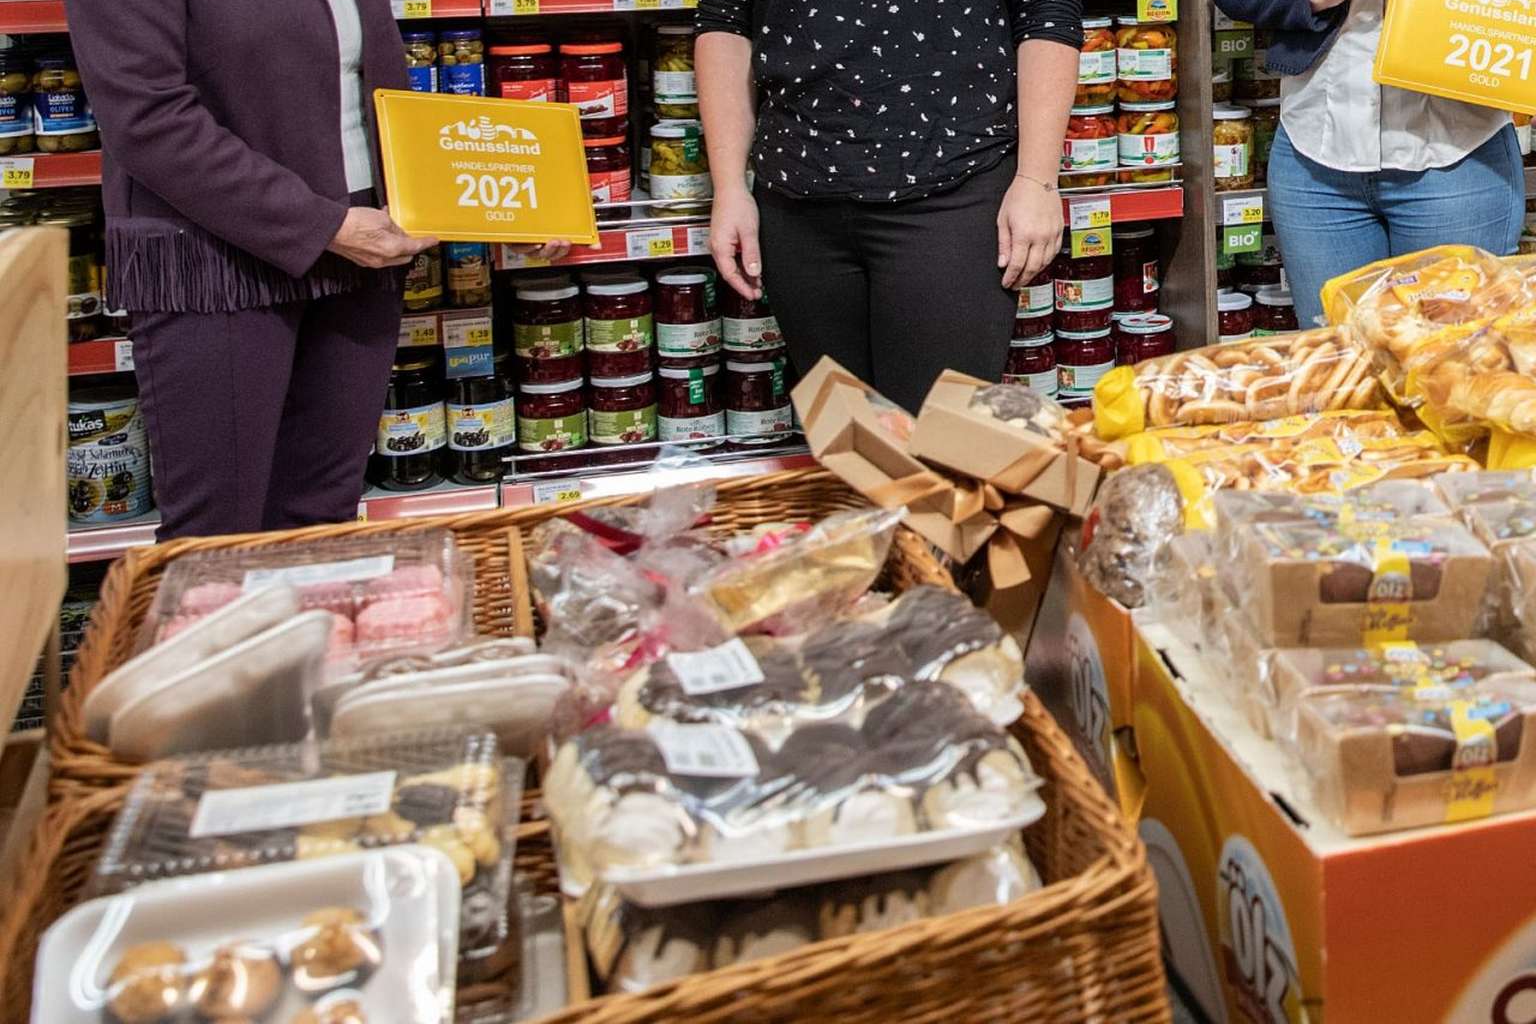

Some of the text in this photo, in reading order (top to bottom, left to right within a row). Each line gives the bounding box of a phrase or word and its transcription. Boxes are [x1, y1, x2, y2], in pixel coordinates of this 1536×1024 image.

[407, 2, 427, 12] 3.79
[1450, 20, 1536, 45] HANDELSPARTNER
[1220, 41, 1246, 52] BIO
[1445, 34, 1533, 81] 2021
[1469, 73, 1500, 88] GOLD
[440, 137, 541, 156] Genussland
[451, 162, 535, 173] HANDELSPARTNER
[8, 170, 30, 180] 3.79
[456, 174, 537, 209] 2021
[486, 212, 515, 221] GOLD
[652, 240, 671, 250] 1.29
[1229, 234, 1254, 247] BIO
